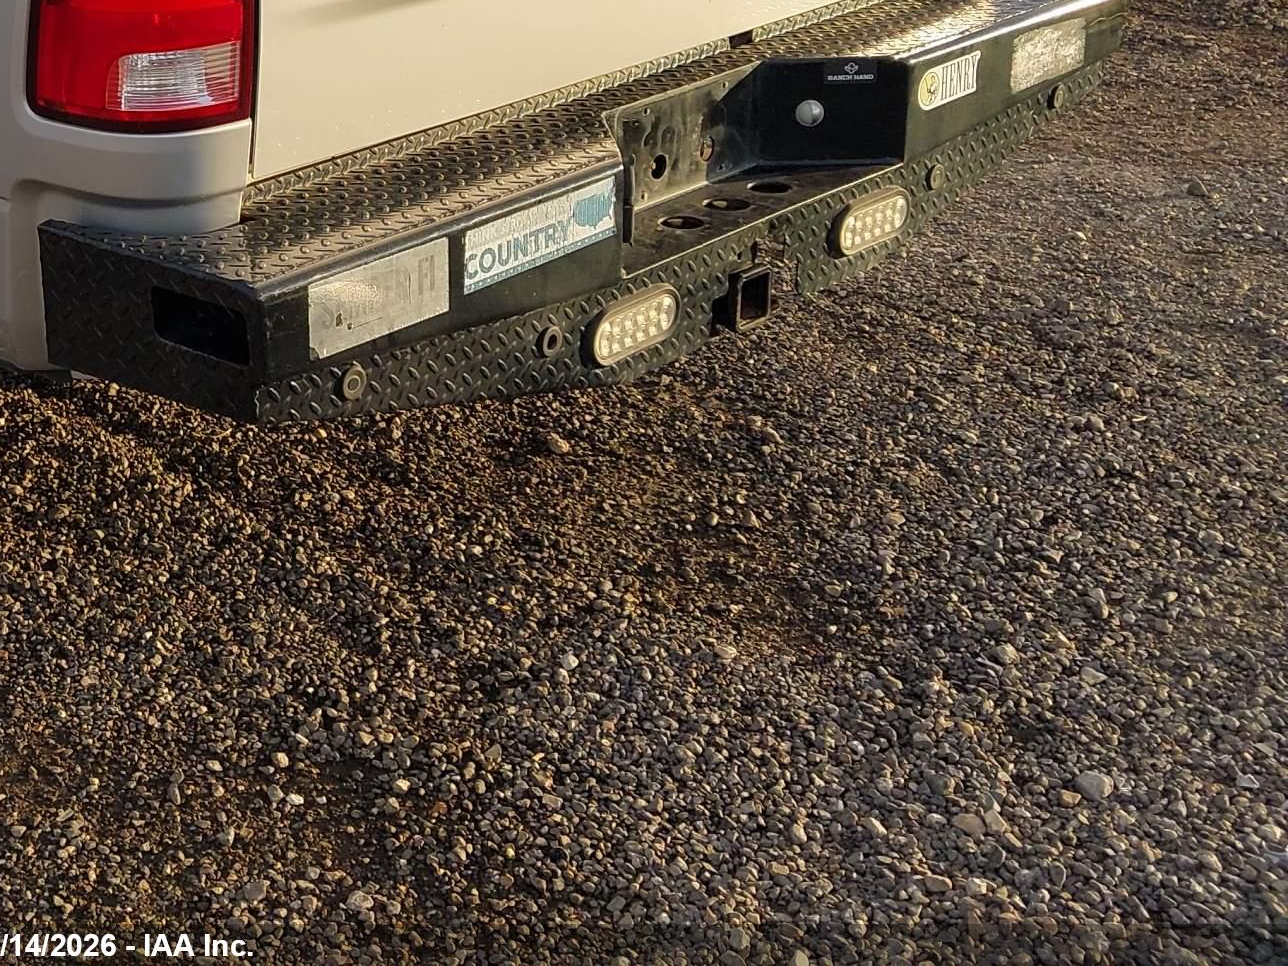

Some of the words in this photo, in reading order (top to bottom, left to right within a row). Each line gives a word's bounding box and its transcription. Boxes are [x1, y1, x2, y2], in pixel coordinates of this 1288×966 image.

[853, 72, 875, 81] HAND
[940, 56, 980, 100] HENRY
[464, 218, 572, 280] COUNTRY
